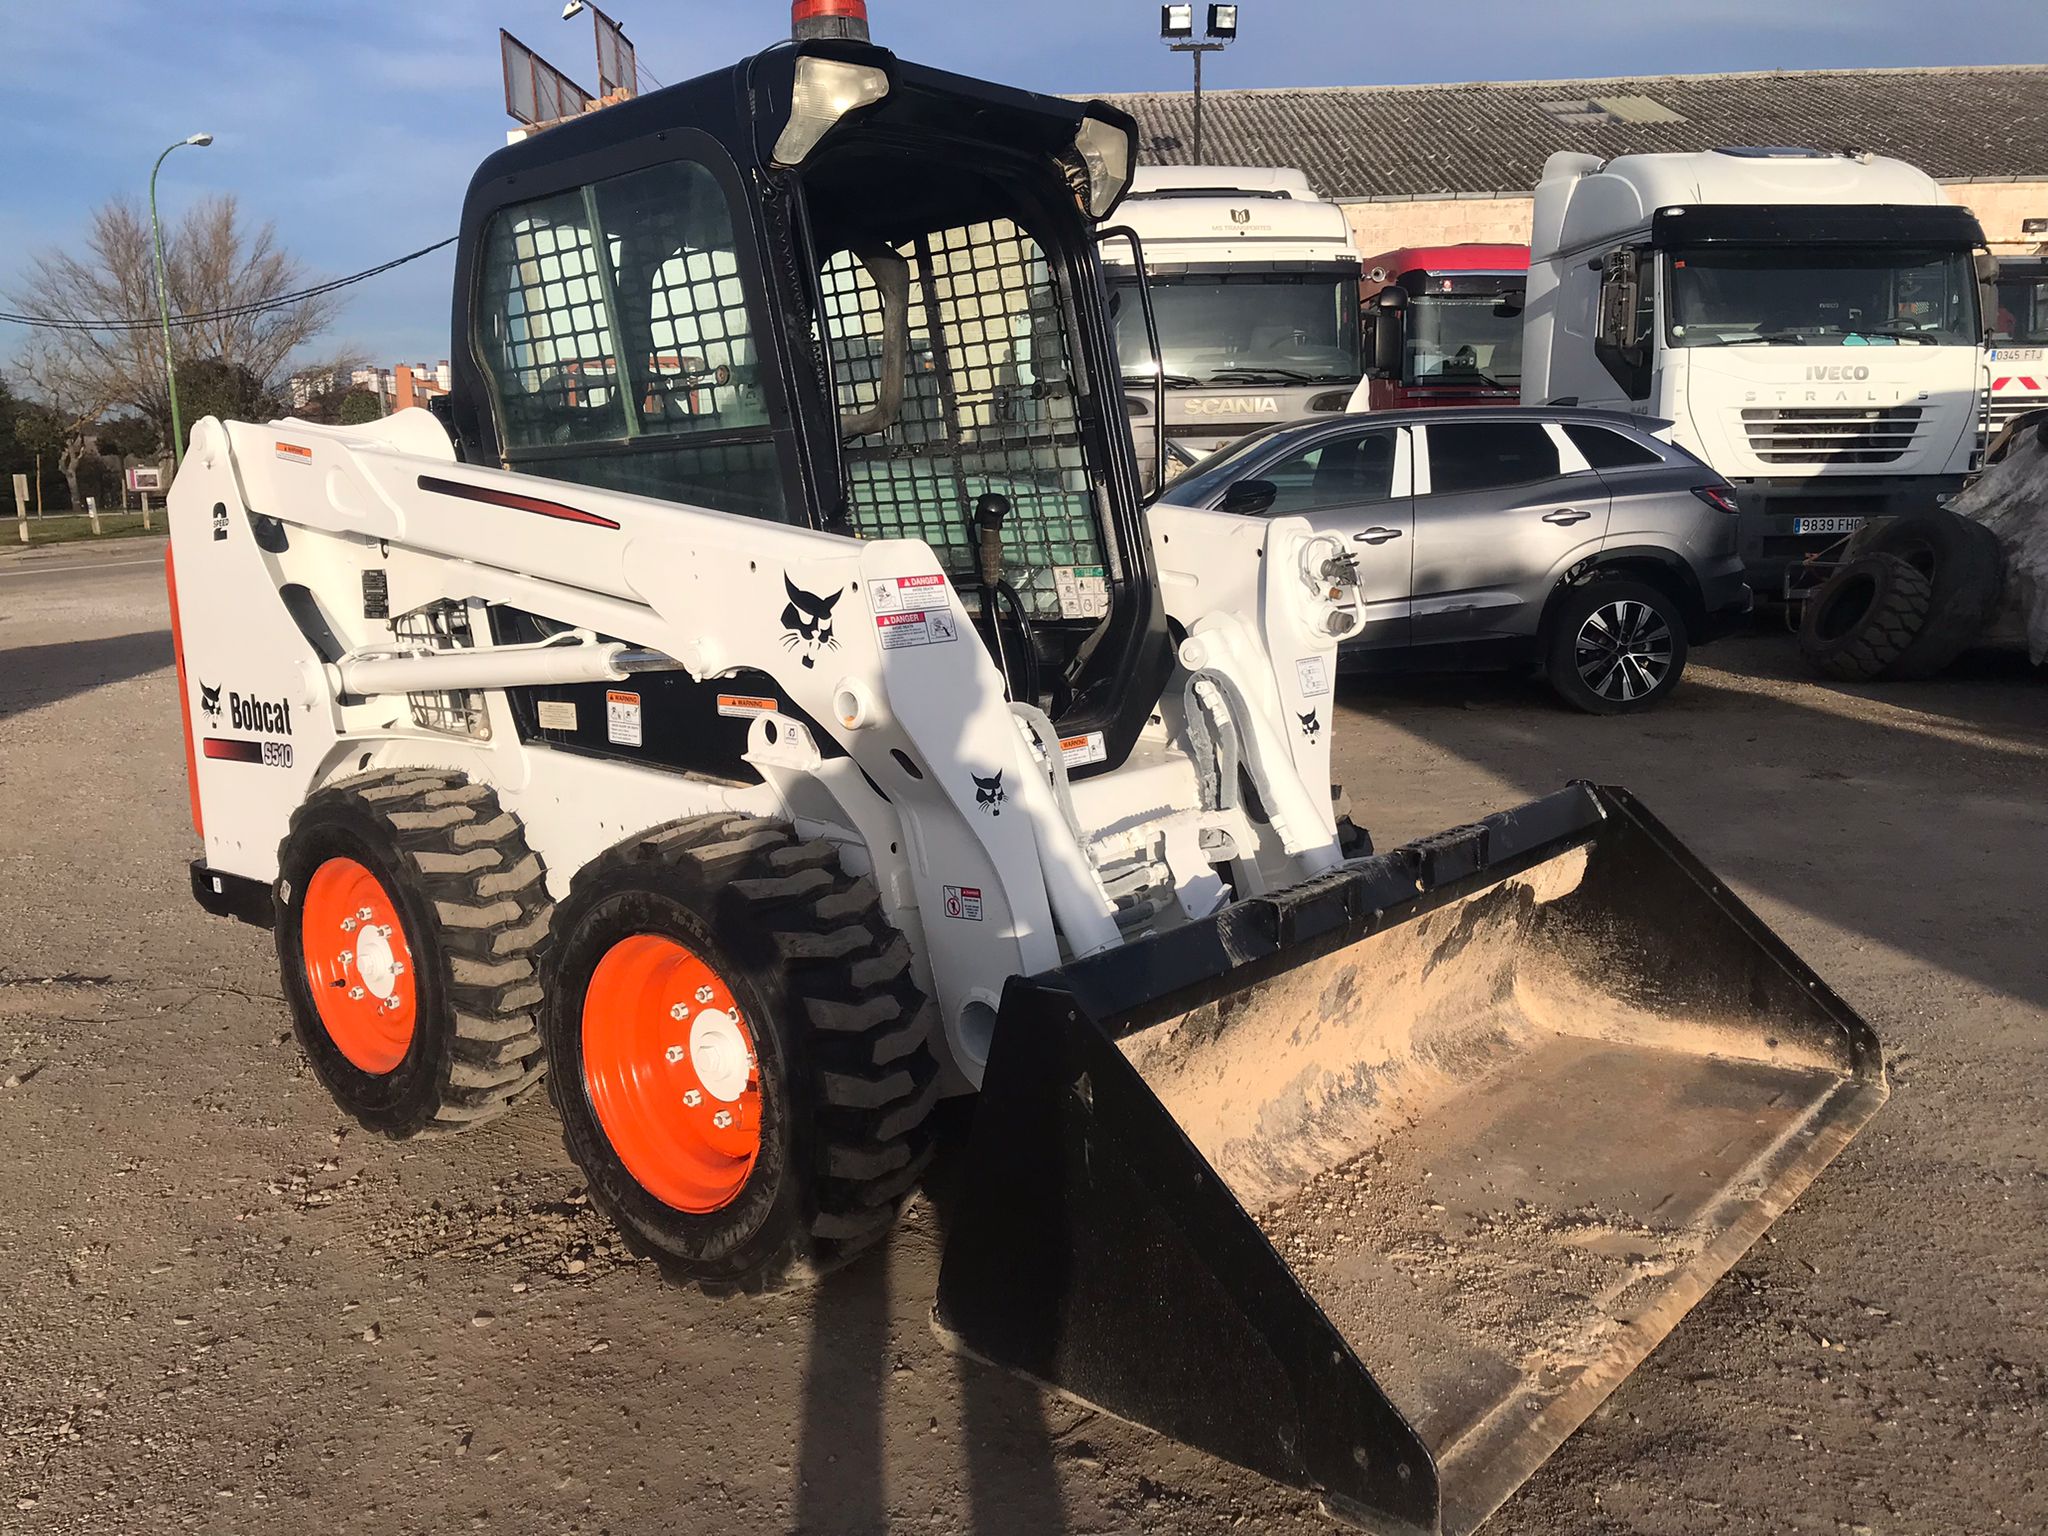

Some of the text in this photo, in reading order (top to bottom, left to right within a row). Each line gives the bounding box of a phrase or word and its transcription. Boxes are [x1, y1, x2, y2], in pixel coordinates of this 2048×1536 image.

[1997, 350, 2042, 361] 0345 FTJ
[1805, 366, 1870, 381] IVECO
[1744, 390, 1929, 402] STRALIS
[1183, 397, 1279, 416] SCANIA
[1802, 518, 1834, 532] 9839
[911, 577, 939, 585] DANGER
[891, 614, 919, 623] DANGER
[615, 695, 637, 703] WARNING
[737, 699, 763, 708] WARNING
[229, 691, 292, 736] Bobcat
[263, 741, 294, 768] S510
